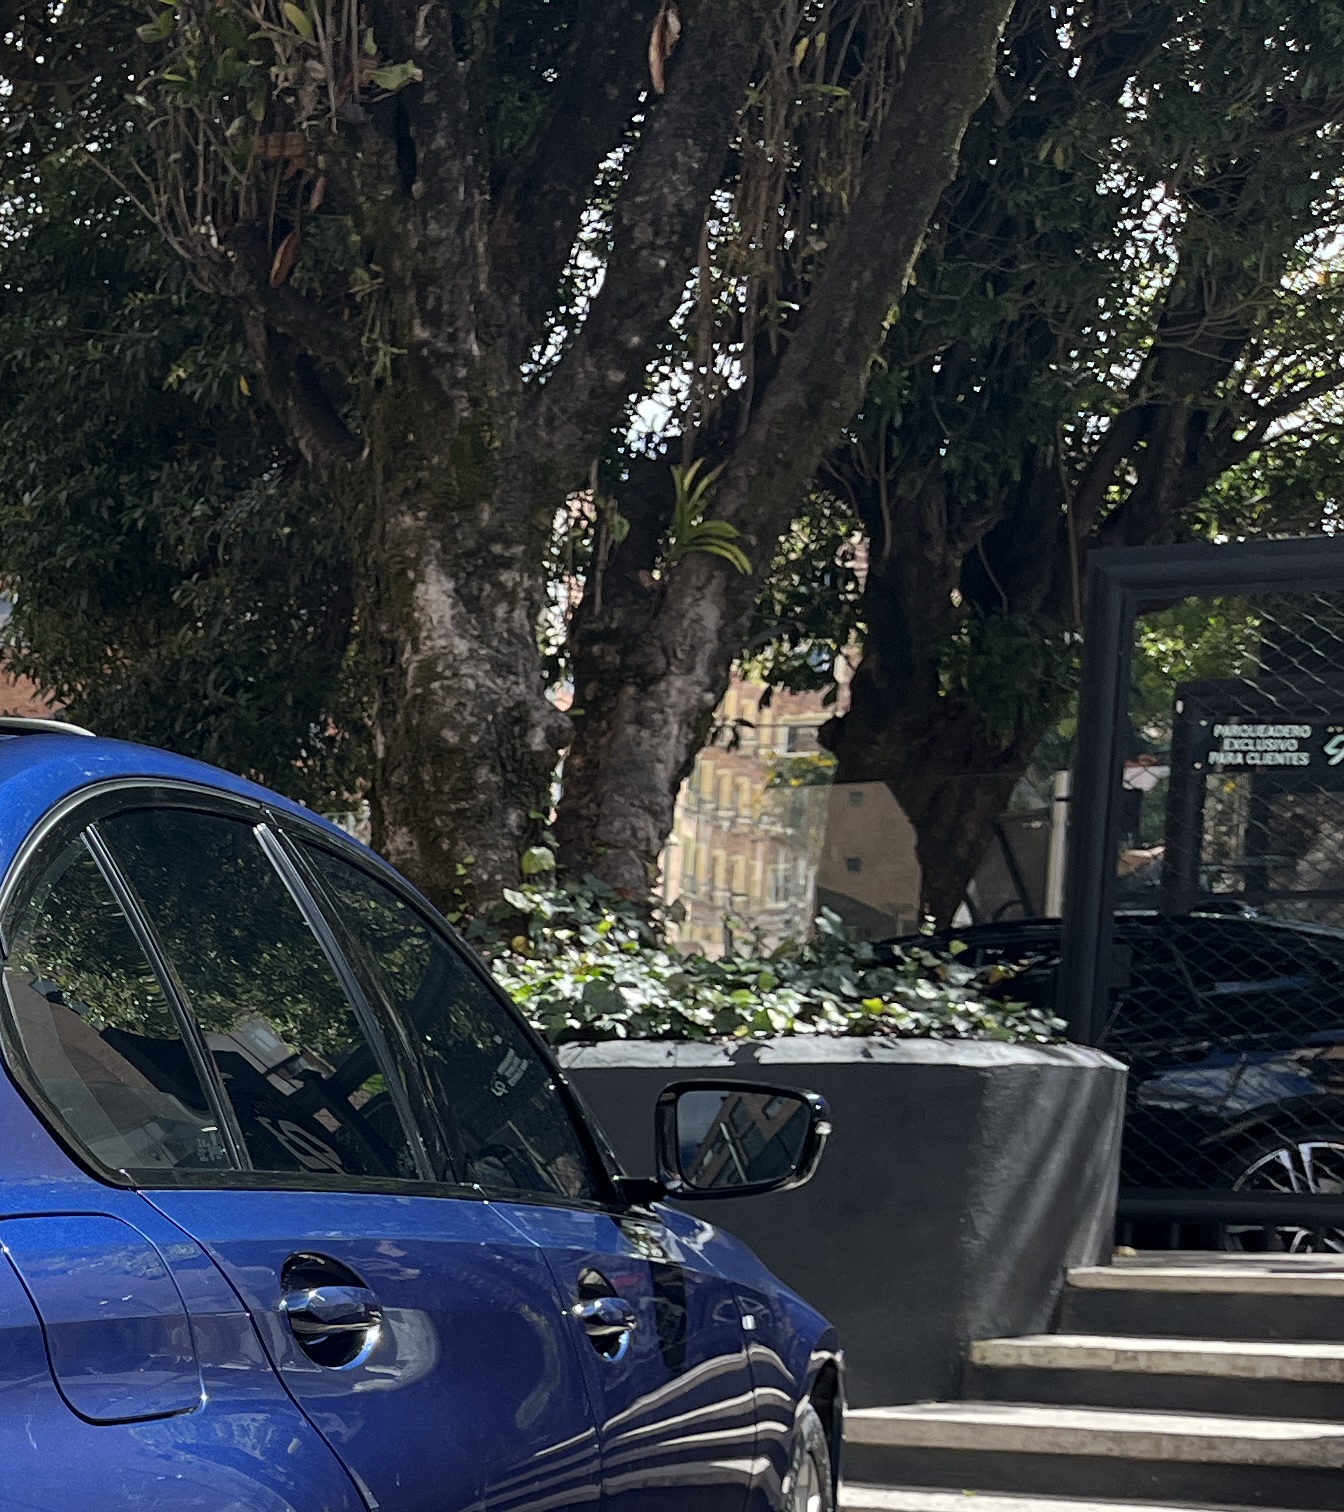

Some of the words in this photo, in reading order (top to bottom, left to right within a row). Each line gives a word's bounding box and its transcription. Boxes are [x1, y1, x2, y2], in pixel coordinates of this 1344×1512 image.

[1213, 724, 1312, 738] PARQUEADERO
[1223, 739, 1299, 752] EXCLUSIVO
[1208, 751, 1244, 765] PARA
[1245, 752, 1311, 766] CLIENTES
